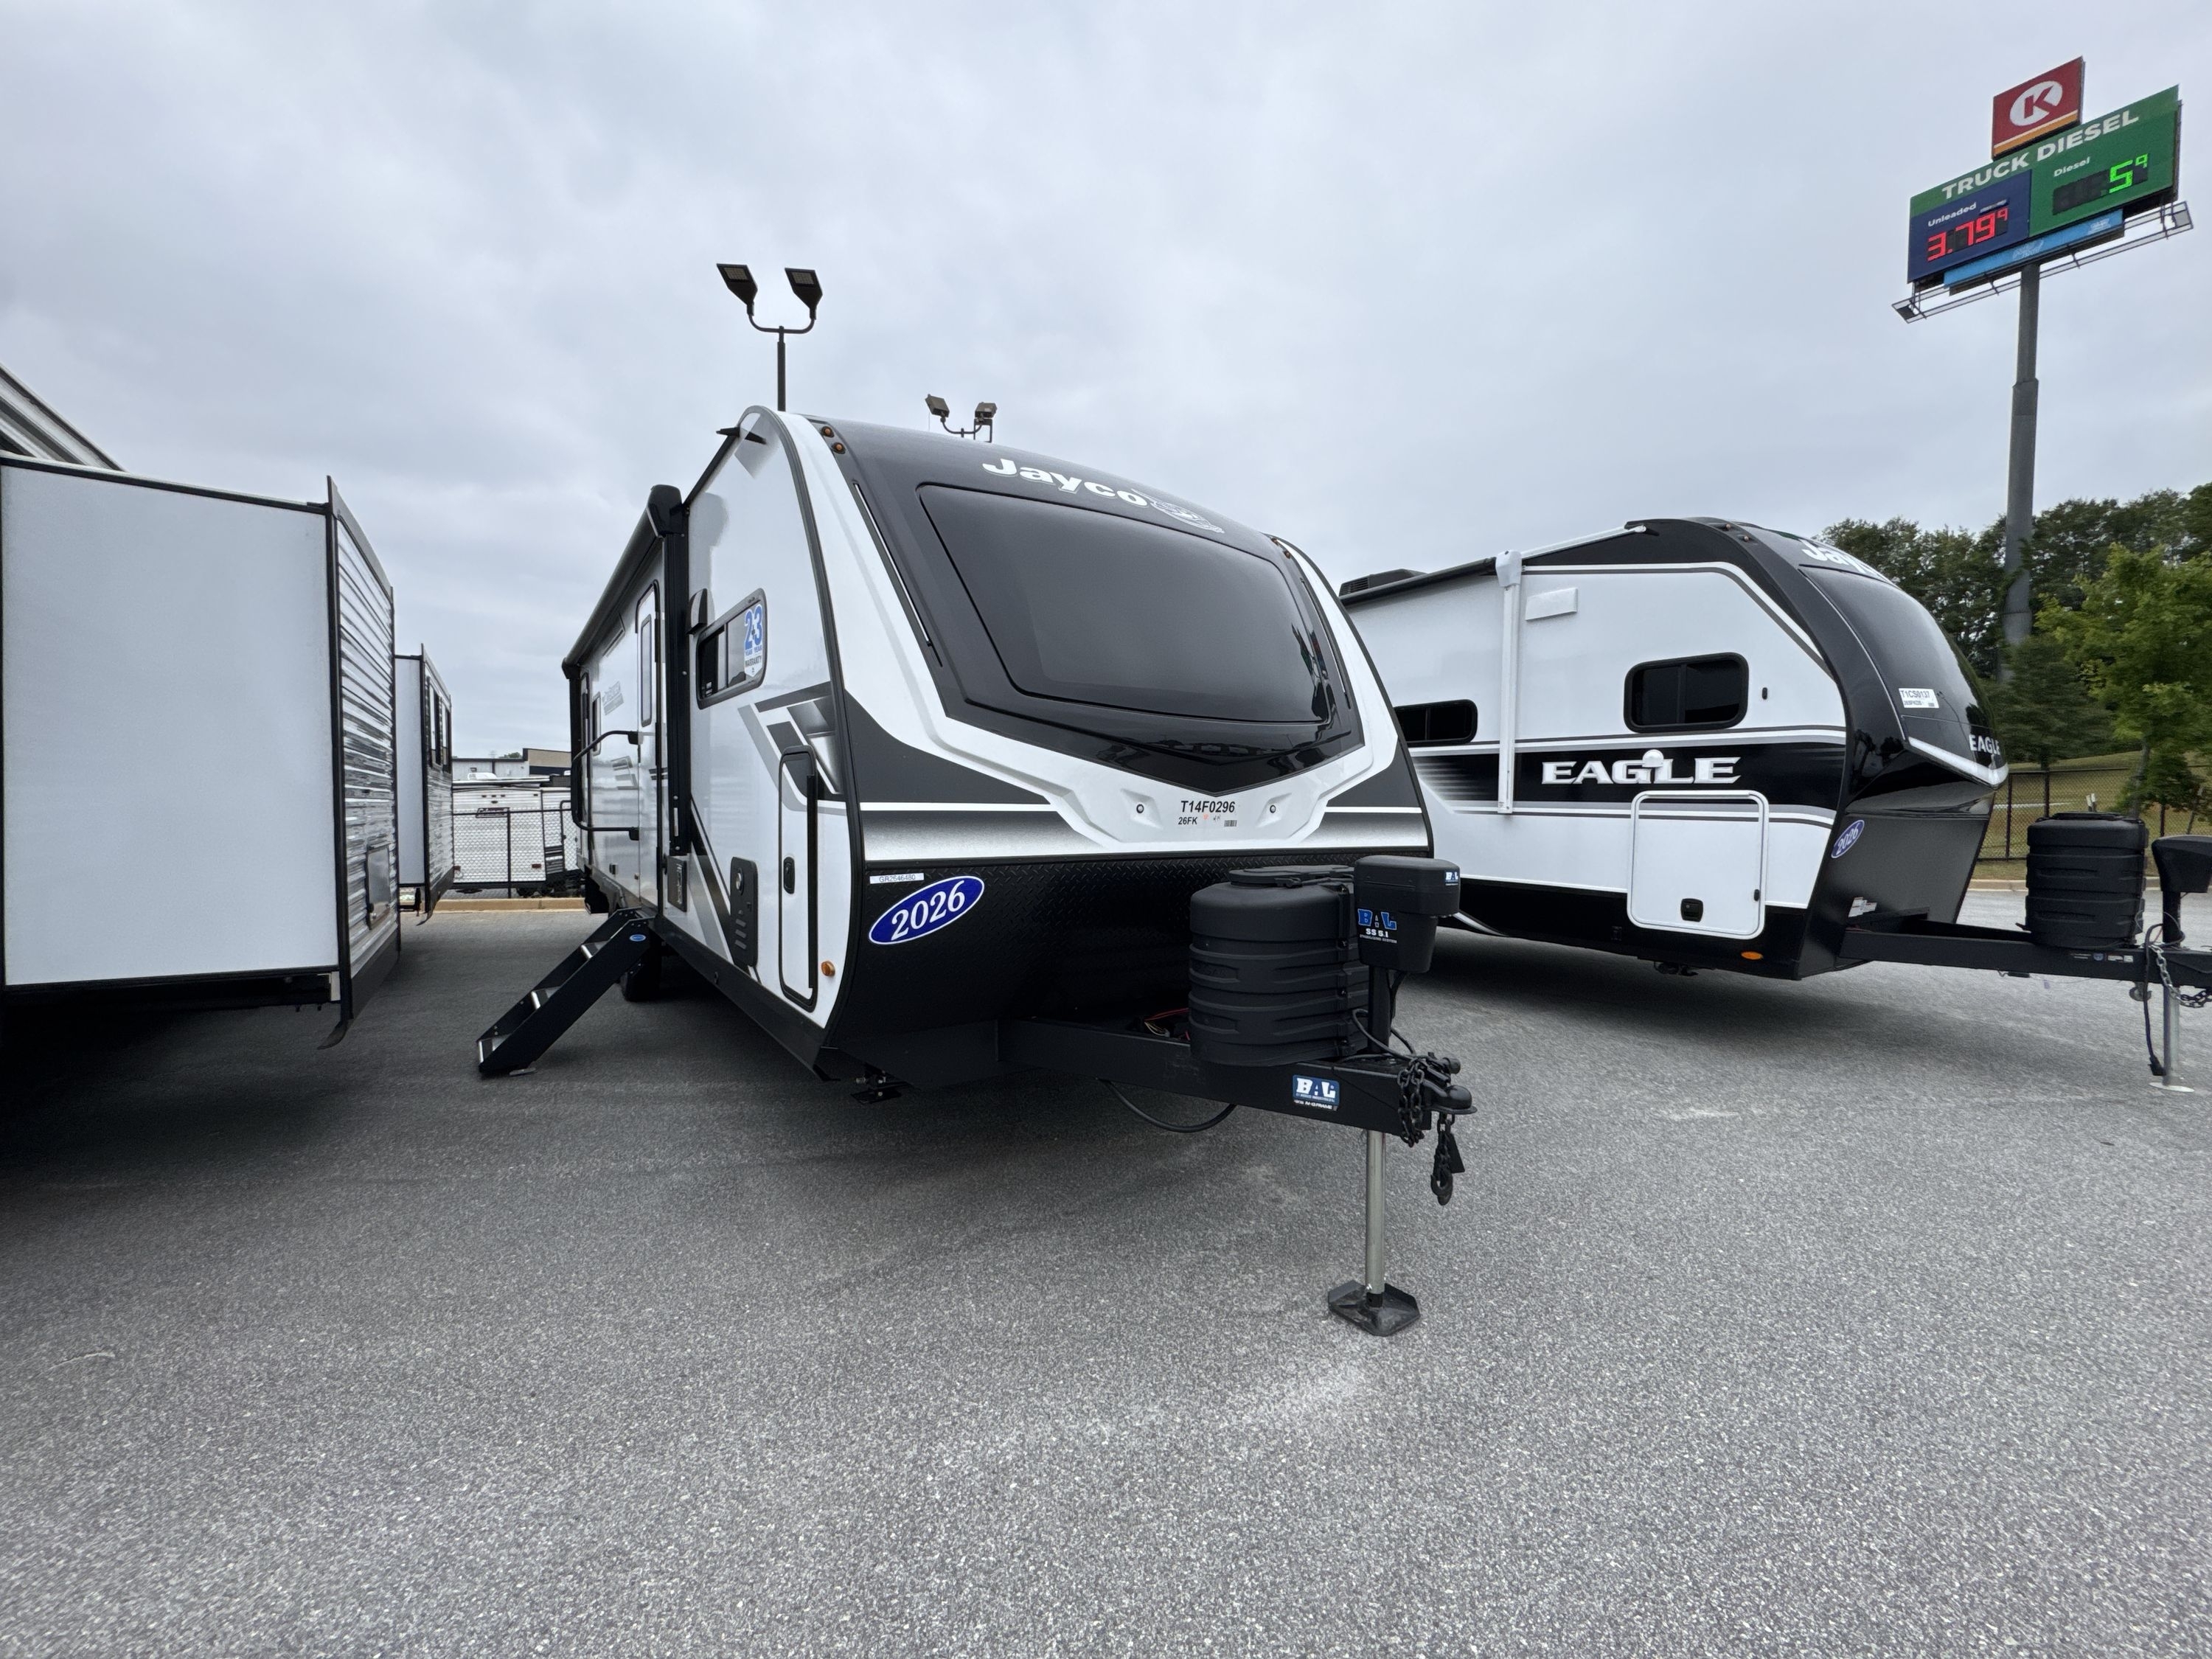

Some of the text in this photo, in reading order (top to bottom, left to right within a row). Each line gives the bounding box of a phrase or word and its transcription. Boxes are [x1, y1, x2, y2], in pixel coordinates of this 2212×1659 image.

[1941, 111, 2139, 200] TRUCK DIESEL
[2053, 156, 2090, 177] Diesel
[1928, 201, 1977, 227] Unleaded
[982, 458, 1148, 507] Jayco
[1969, 734, 2000, 756] EAGLE
[1541, 757, 1742, 785] EAGLE
[1180, 800, 1236, 813] T14F0296
[1178, 816, 1198, 825] 26FK
[1836, 822, 1860, 855] 2026
[879, 874, 916, 883] GR2646480
[891, 880, 965, 941] 2026
[1296, 1077, 1336, 1099] BAL
